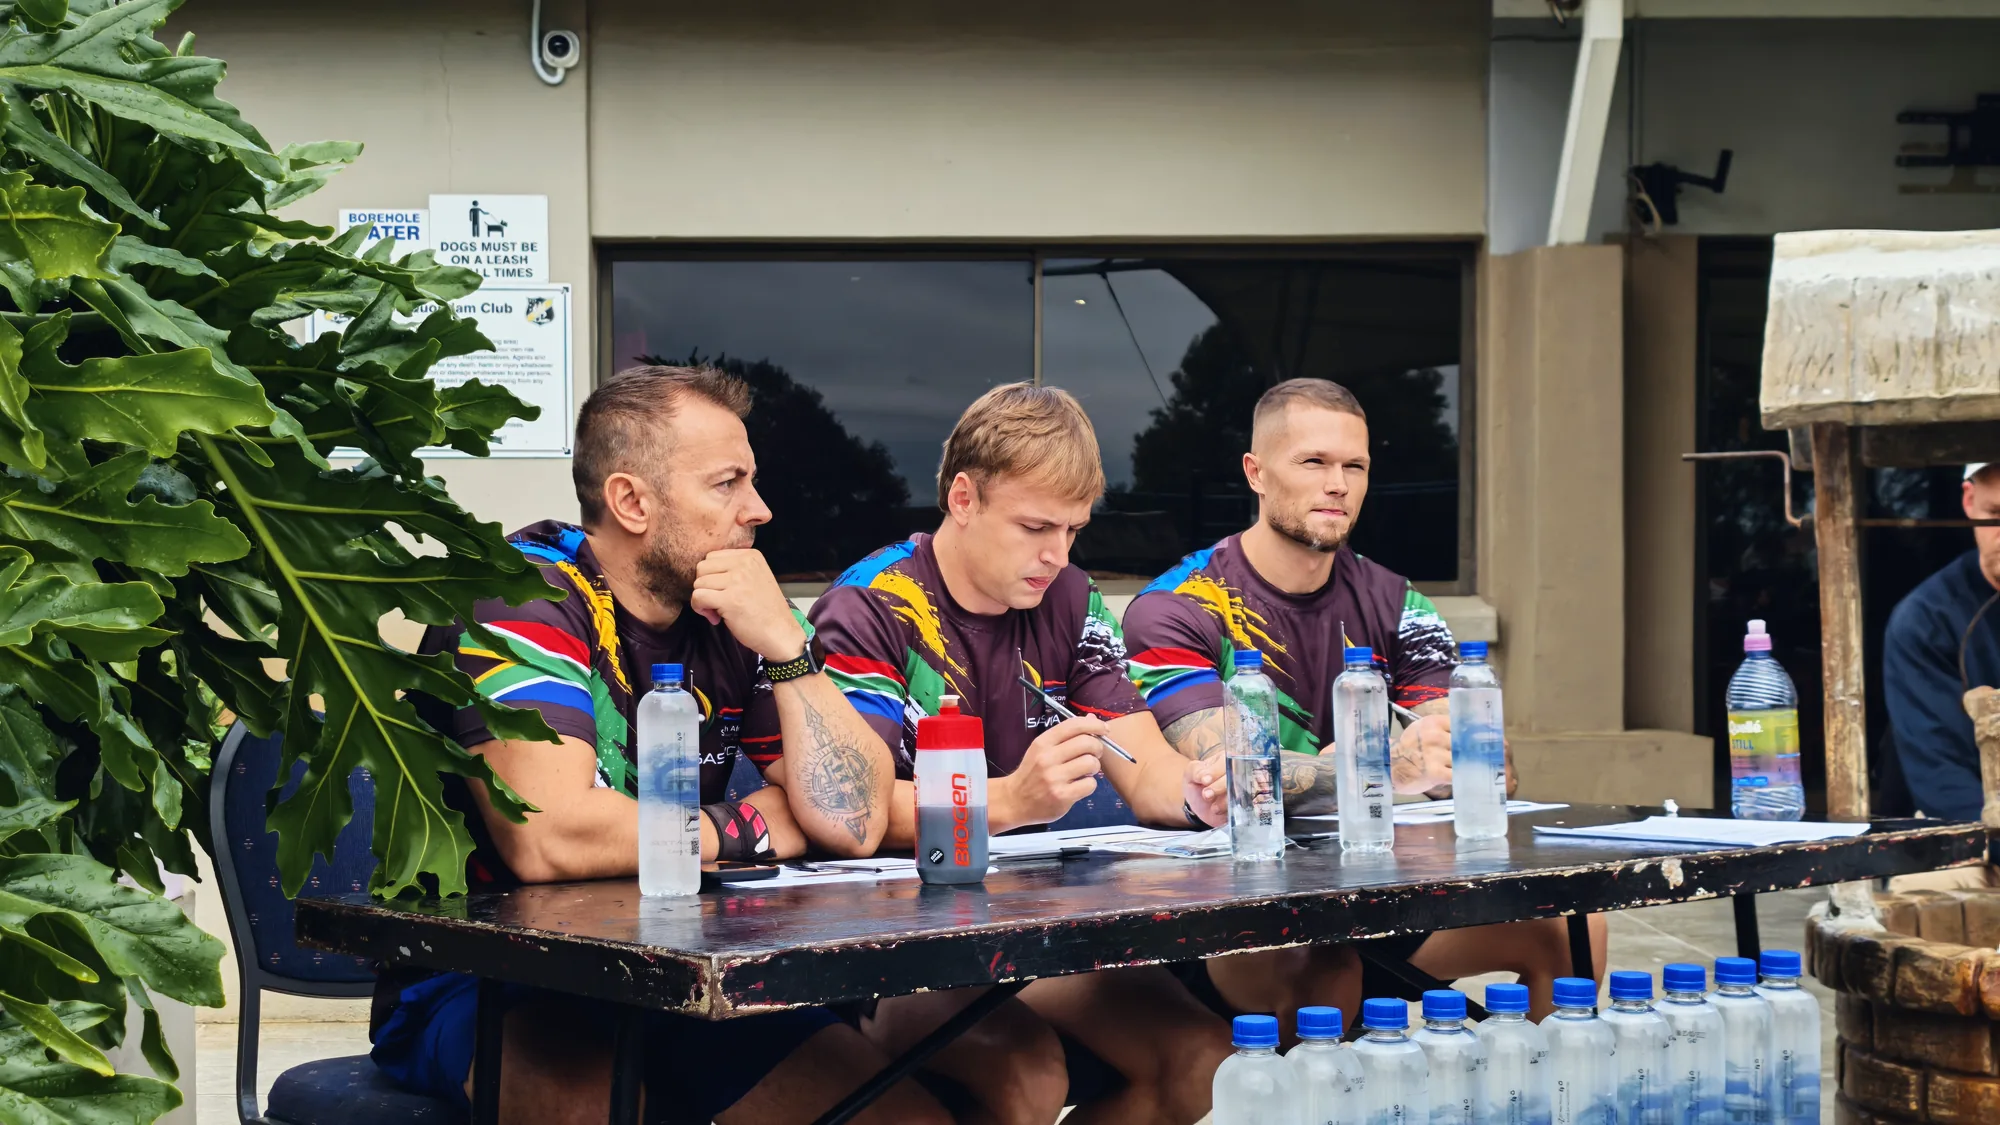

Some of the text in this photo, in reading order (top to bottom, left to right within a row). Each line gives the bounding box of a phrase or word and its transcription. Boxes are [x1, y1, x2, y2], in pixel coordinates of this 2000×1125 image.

[349, 213, 420, 223] BOREHOLE
[349, 225, 420, 240] ATER
[440, 242, 538, 252] DOGS MUST BE
[451, 255, 528, 265] ON A LEASH
[494, 268, 533, 277] TIMES
[480, 302, 513, 314] Club
